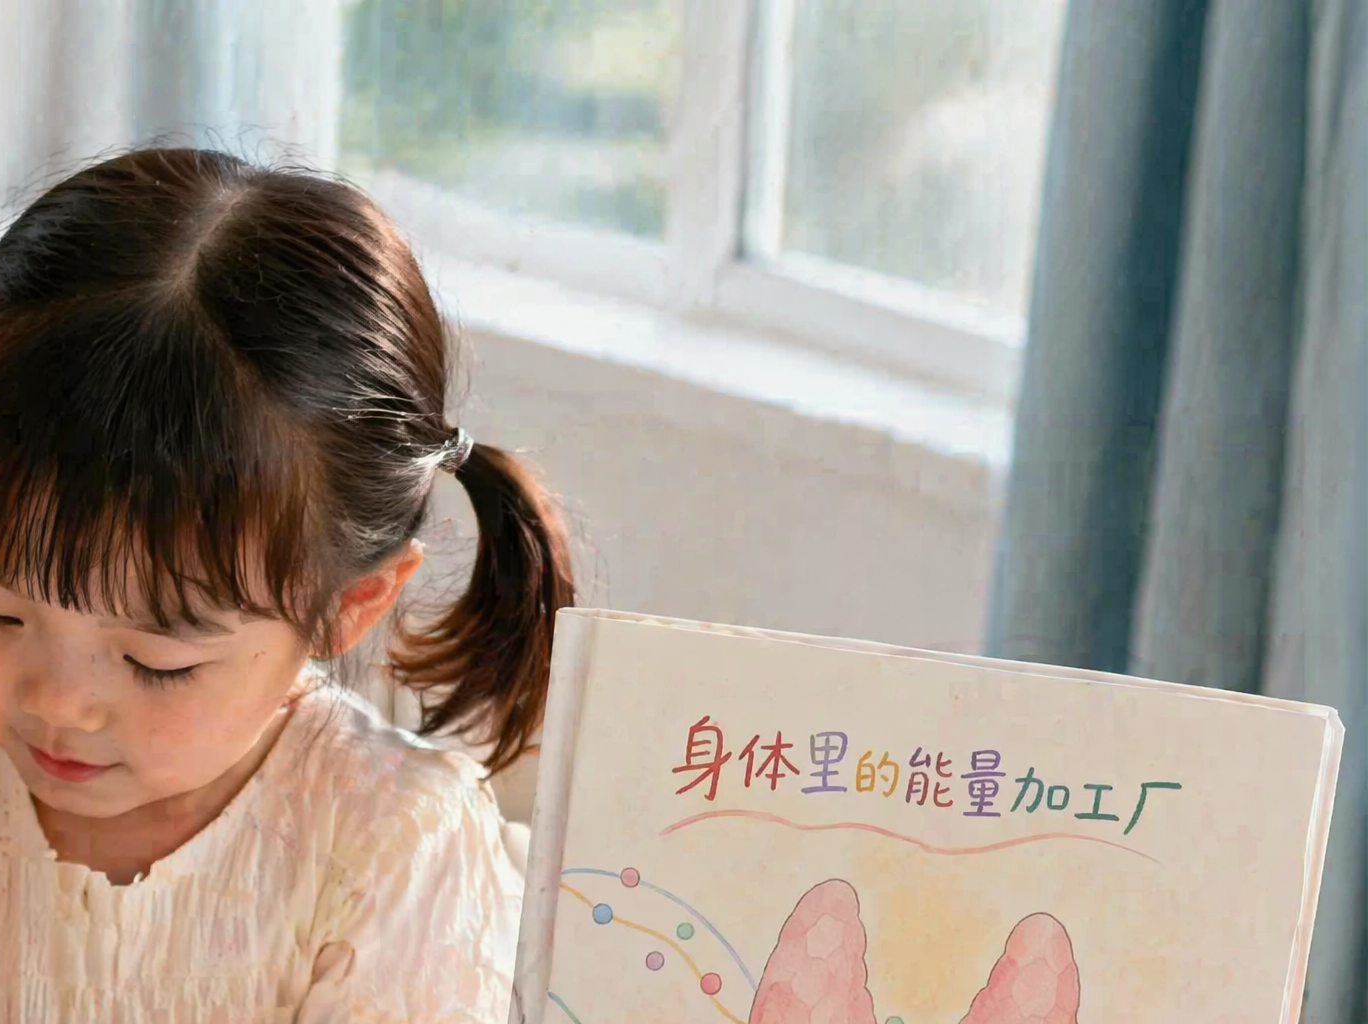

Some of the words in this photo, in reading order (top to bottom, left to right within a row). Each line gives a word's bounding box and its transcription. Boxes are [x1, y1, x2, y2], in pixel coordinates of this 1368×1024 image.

[671, 715, 1182, 835] 身体里的能量加工厂
